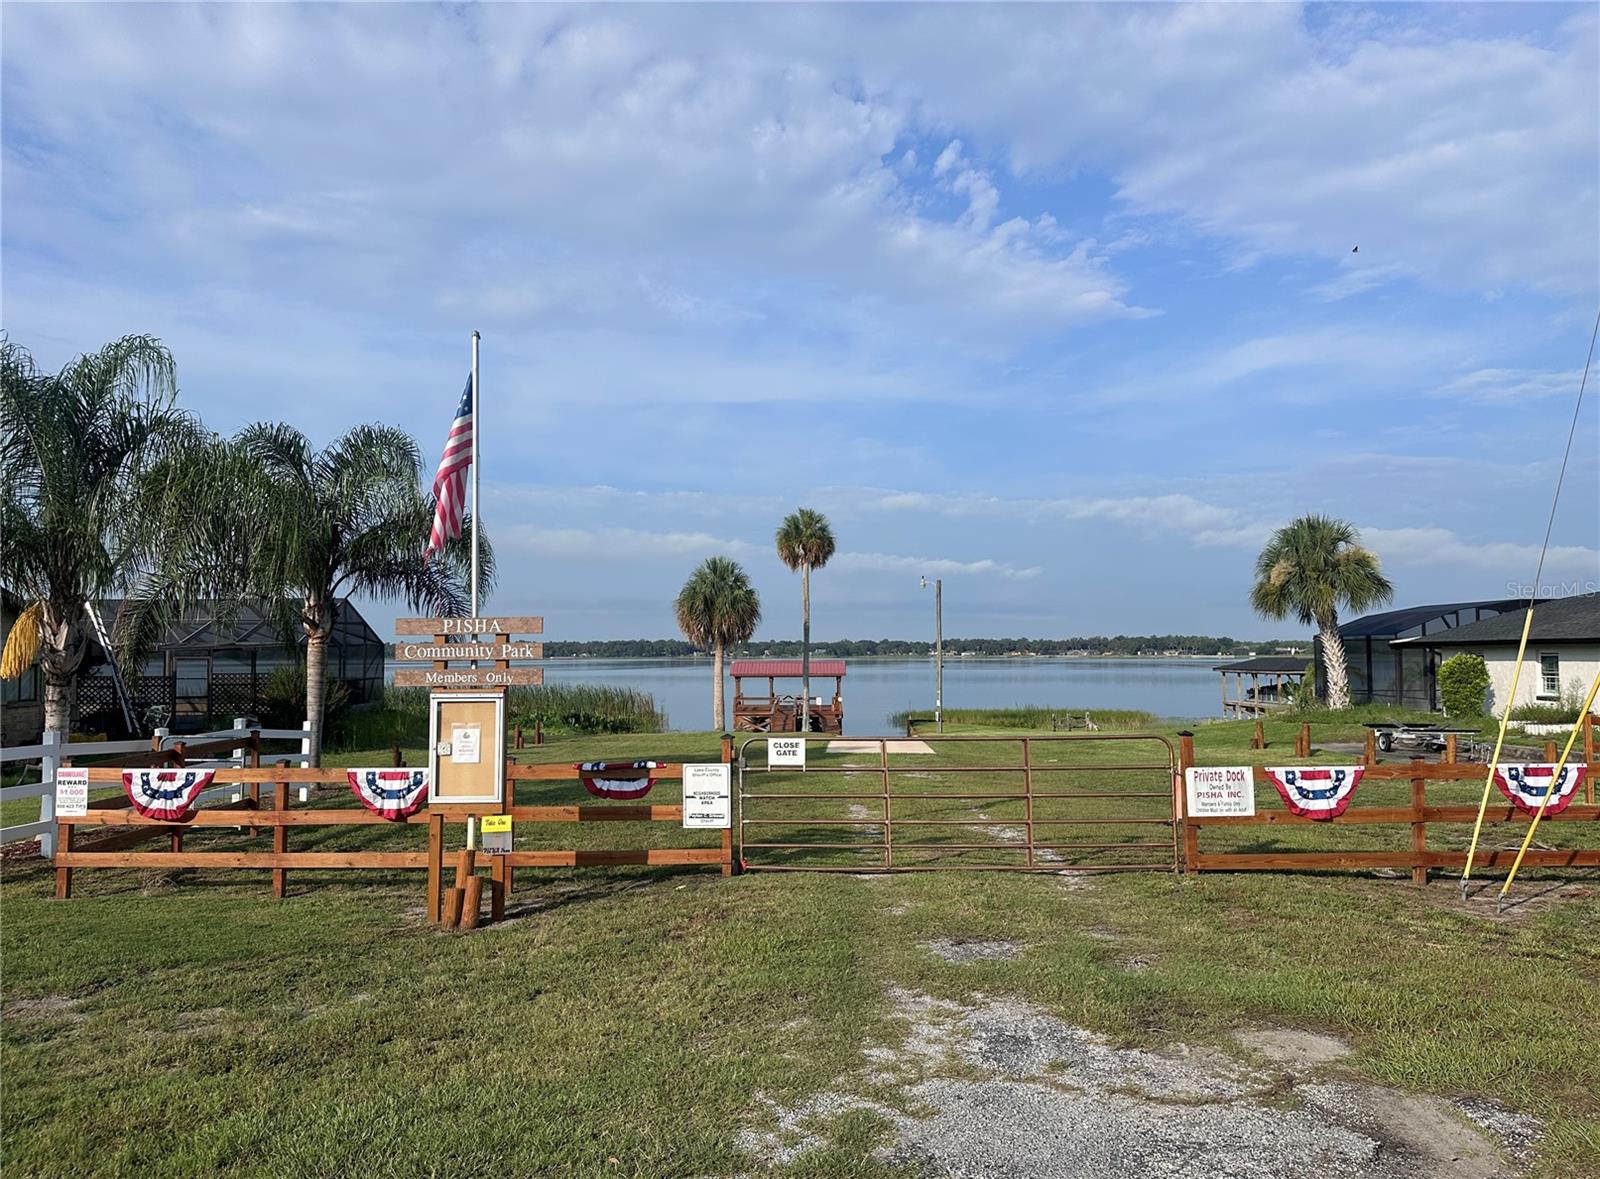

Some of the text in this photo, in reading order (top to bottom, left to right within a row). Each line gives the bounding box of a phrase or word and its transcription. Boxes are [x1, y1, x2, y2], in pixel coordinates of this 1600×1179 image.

[443, 619, 503, 633] PISHA
[404, 644, 534, 660] Community Park
[425, 672, 514, 686] Members Only
[1194, 769, 1245, 782] Private Dock
[1197, 791, 1223, 799] PISHA
